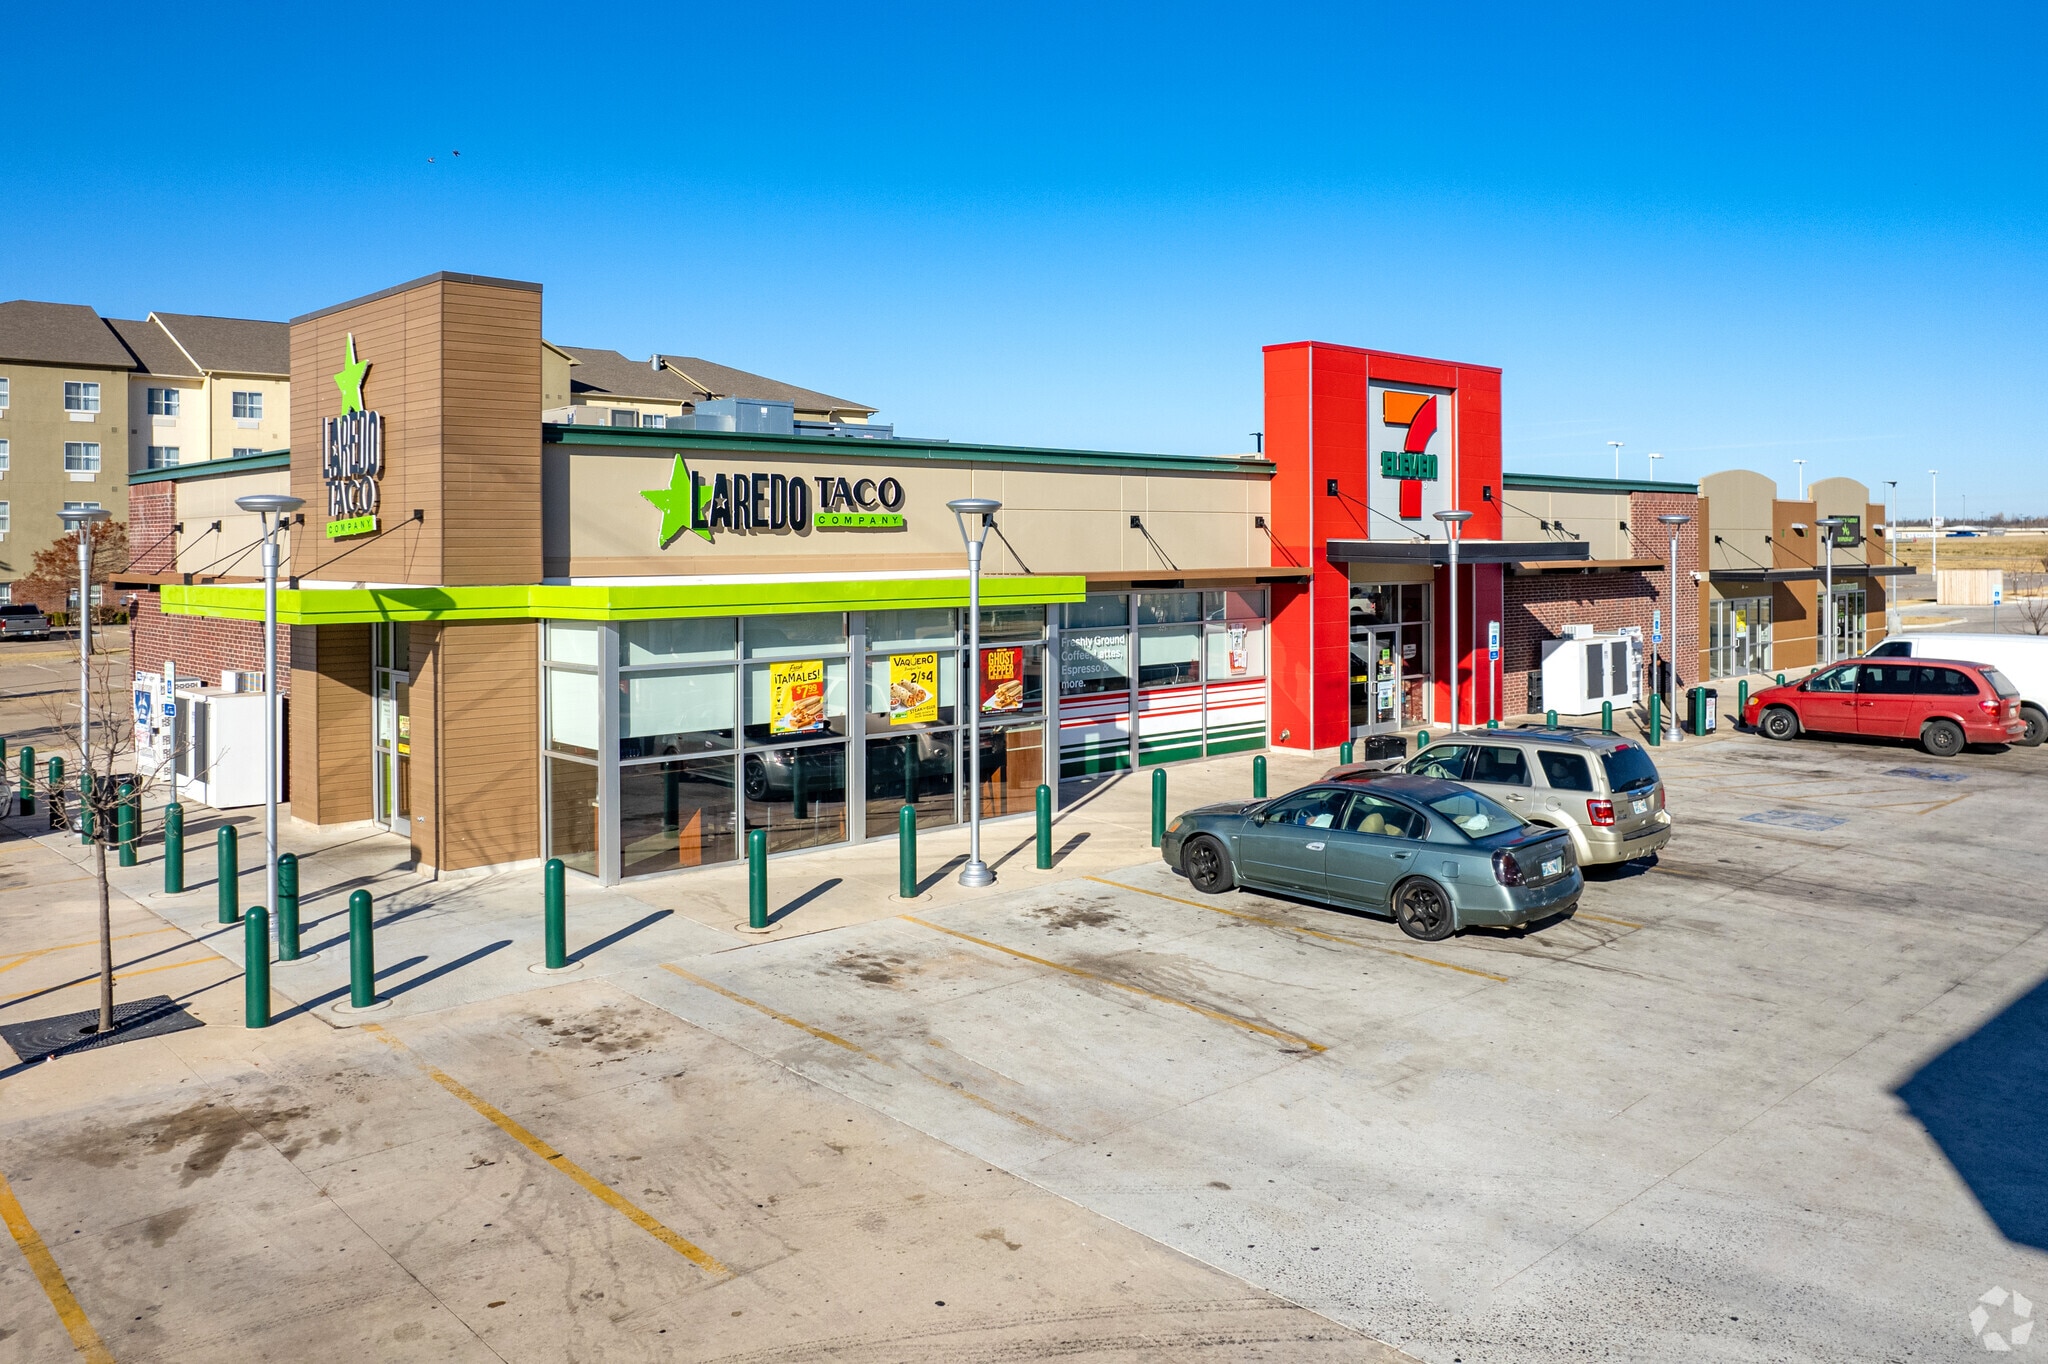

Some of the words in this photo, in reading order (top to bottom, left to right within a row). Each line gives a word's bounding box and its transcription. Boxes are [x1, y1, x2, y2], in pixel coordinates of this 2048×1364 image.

[323, 410, 381, 479] LAREDO
[1383, 390, 1437, 518] 7
[325, 476, 378, 516] TACO
[690, 470, 807, 531] LAREDO
[814, 476, 903, 508] TACO
[328, 518, 373, 534] COMPANY
[818, 515, 899, 525] COMPANY
[1061, 636, 1093, 649] Freshly
[1094, 634, 1125, 646] Ground
[988, 651, 1015, 665] GHOST
[1061, 650, 1092, 661] Coffee,
[988, 664, 1014, 676] PEPPER
[1061, 664, 1101, 677] Espresso
[1102, 663, 1110, 672] &
[910, 671, 934, 684] 2/$4
[1061, 680, 1087, 690] more.
